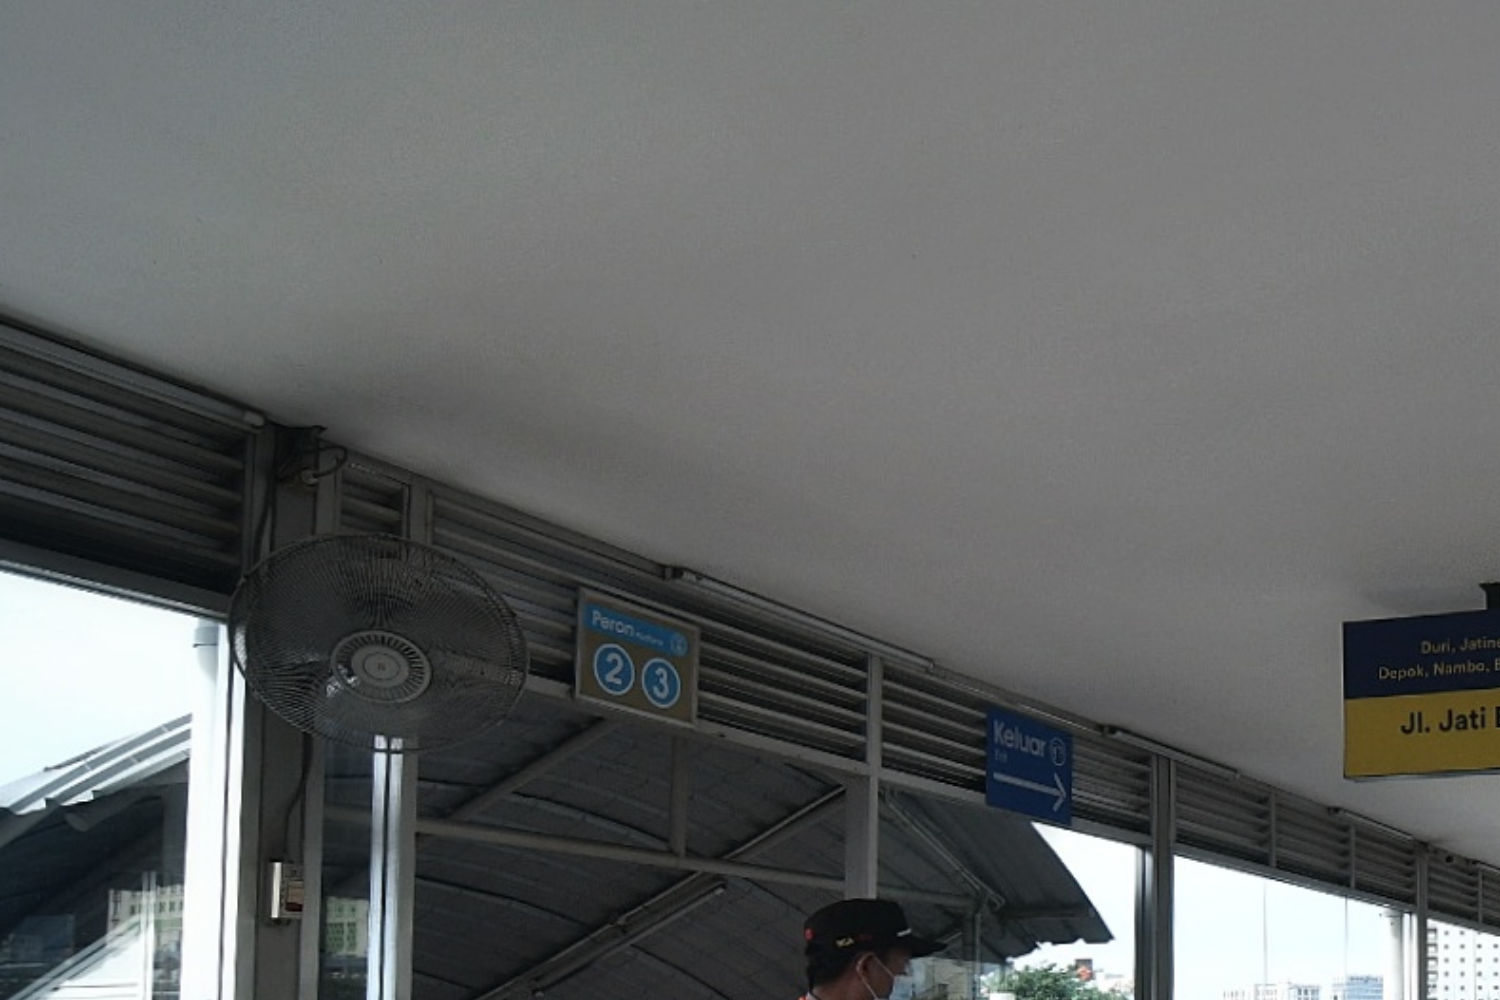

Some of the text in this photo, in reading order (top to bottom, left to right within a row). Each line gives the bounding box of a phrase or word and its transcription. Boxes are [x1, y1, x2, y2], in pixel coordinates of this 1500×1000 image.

[592, 609, 635, 637] Peron
[1421, 639, 1456, 654] Duri,
[605, 652, 669, 699] 2 3
[1378, 663, 1428, 681] Depok,
[1433, 659, 1490, 675] Nambo,
[1401, 711, 1430, 735] Jl.
[1439, 706, 1486, 732] Jati
[993, 719, 1047, 757] Keluar
